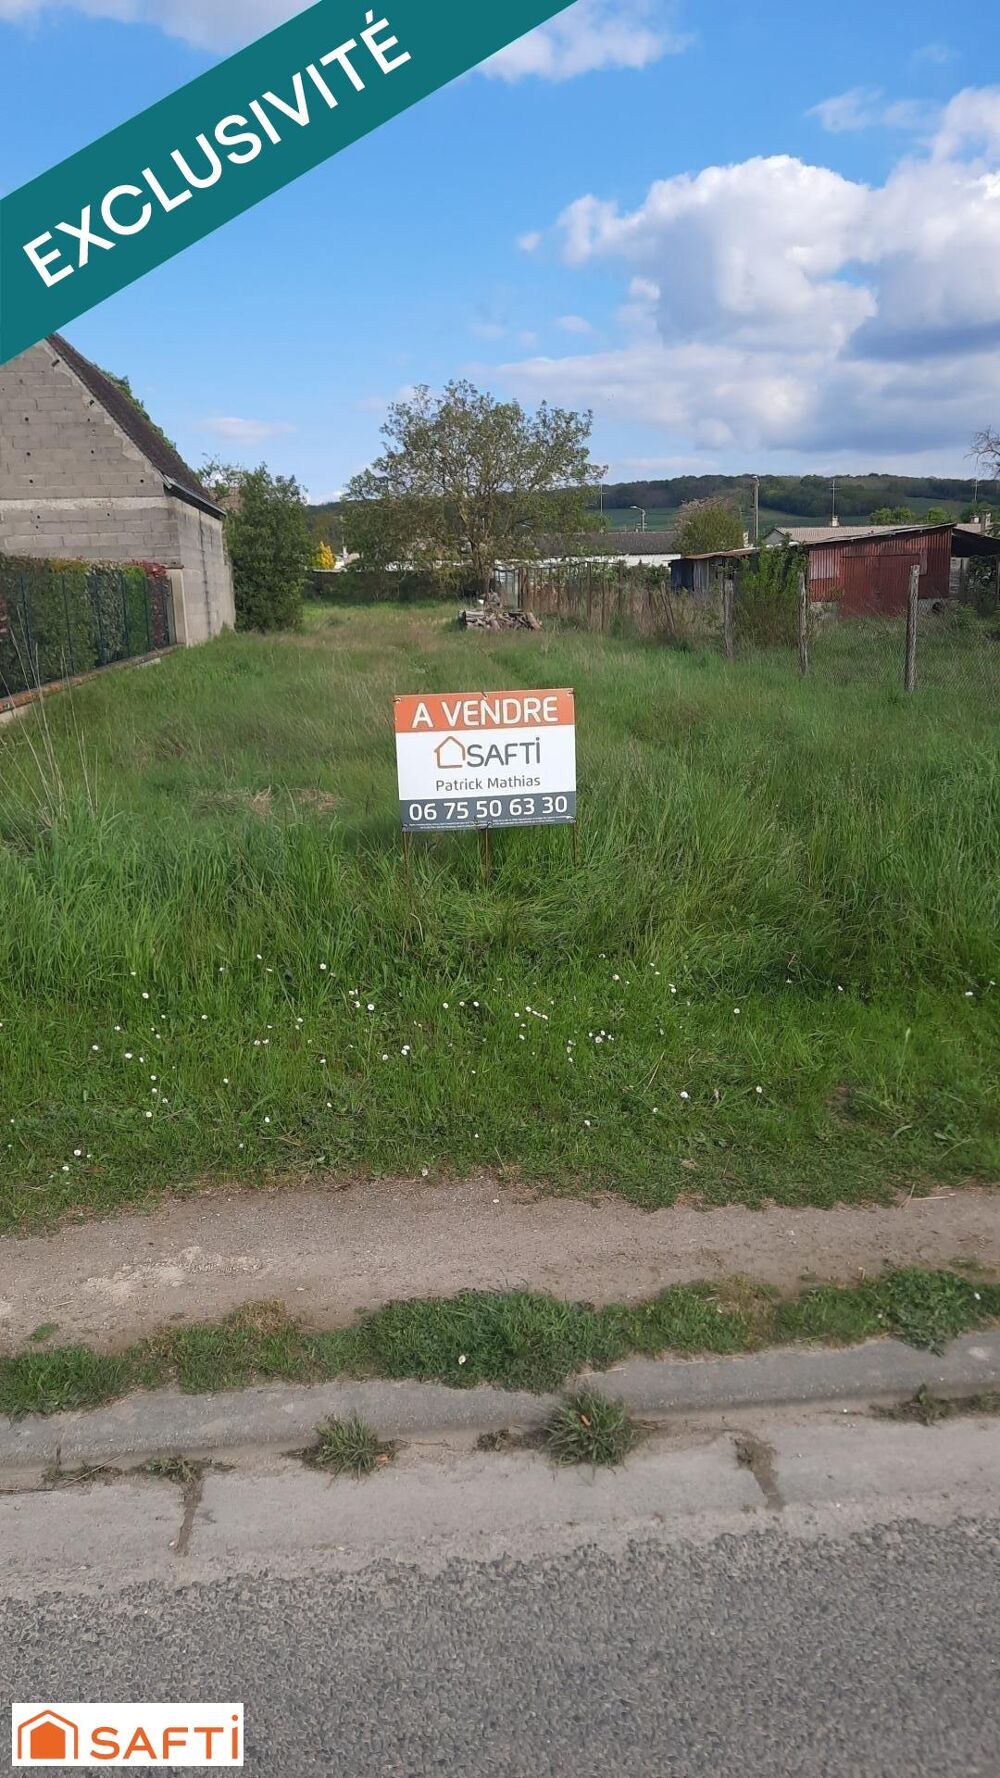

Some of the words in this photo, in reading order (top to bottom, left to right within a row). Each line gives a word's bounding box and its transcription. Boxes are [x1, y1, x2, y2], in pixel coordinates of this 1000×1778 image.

[412, 702, 433, 728] A
[441, 696, 558, 727] VENDRE
[436, 778, 483, 792] Patrick
[487, 775, 541, 789] Mathias
[409, 803, 437, 821] 06
[444, 802, 469, 820] 75
[476, 800, 502, 818] 50
[509, 798, 535, 816] 63
[542, 796, 568, 814] 30
